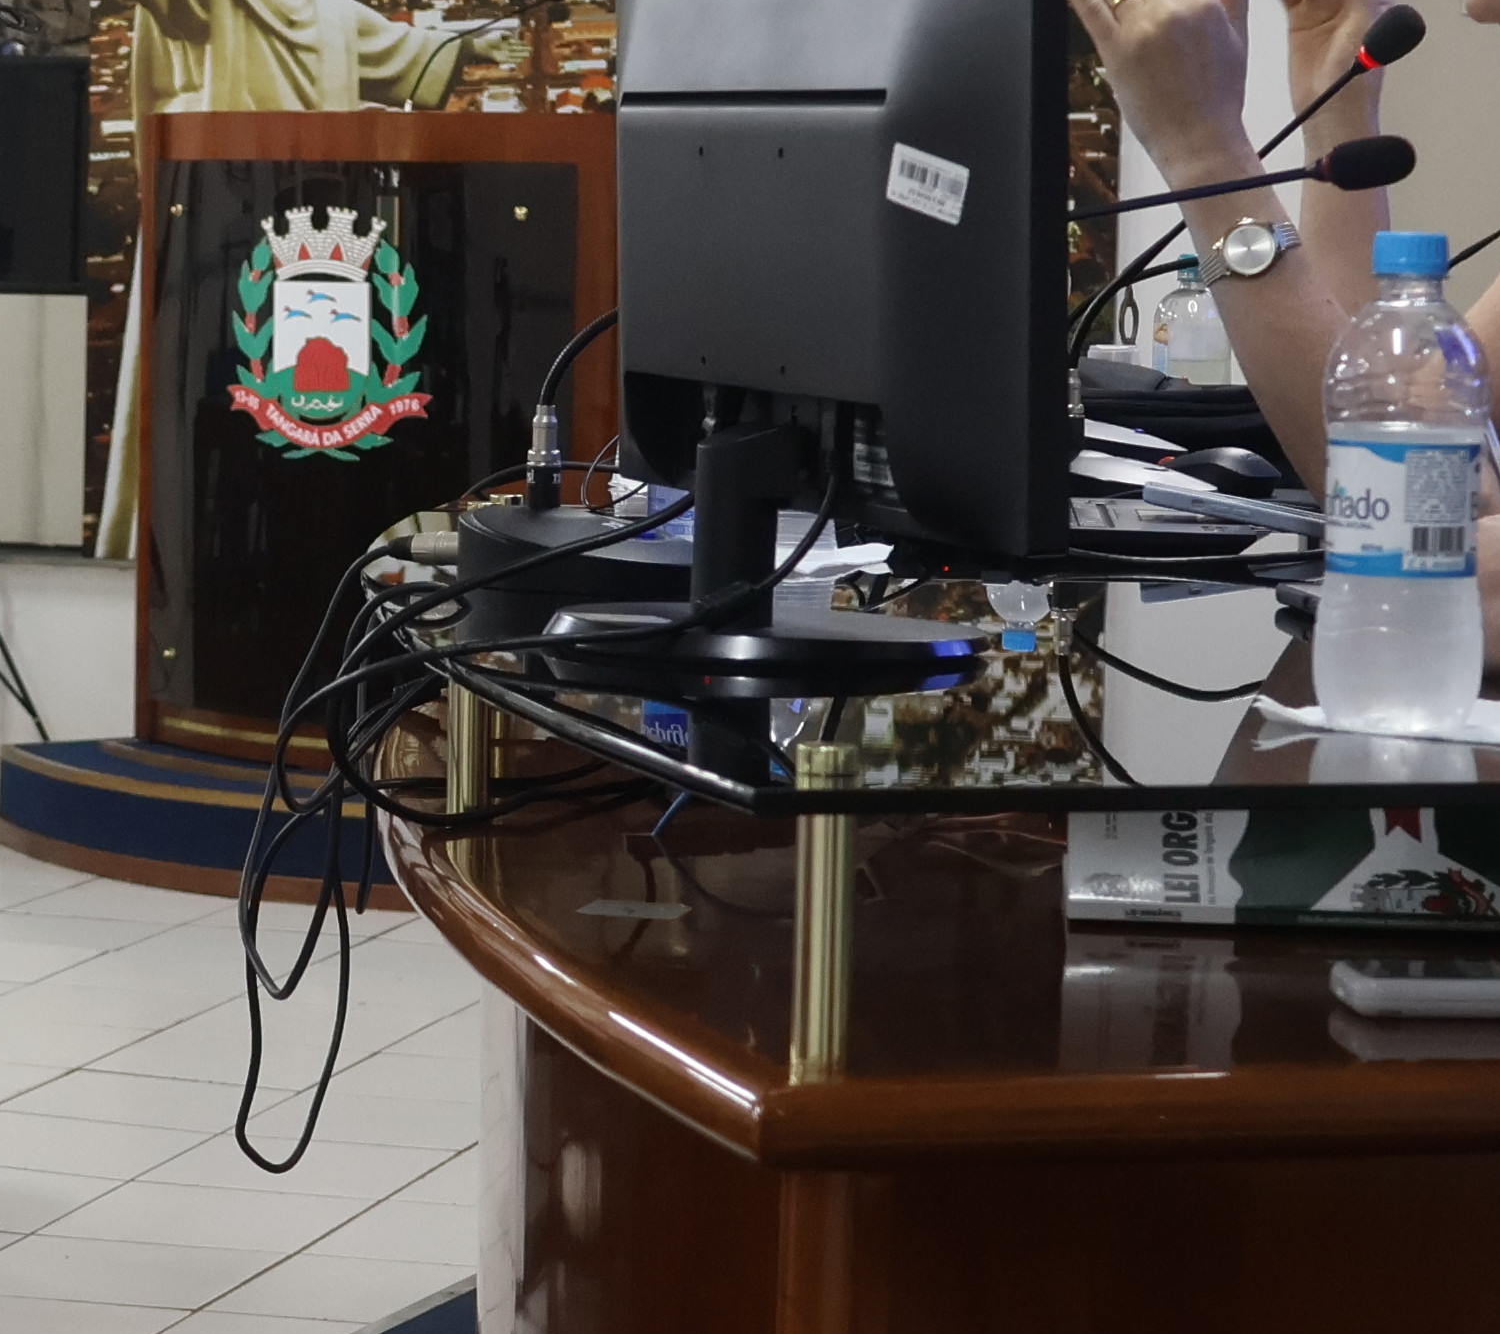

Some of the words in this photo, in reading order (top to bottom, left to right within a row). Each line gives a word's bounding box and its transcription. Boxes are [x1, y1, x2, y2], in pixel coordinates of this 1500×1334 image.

[322, 430, 343, 445] DA
[342, 405, 382, 439] SERRA
[1161, 810, 1198, 866] ORG
[1163, 873, 1200, 903] LEI
